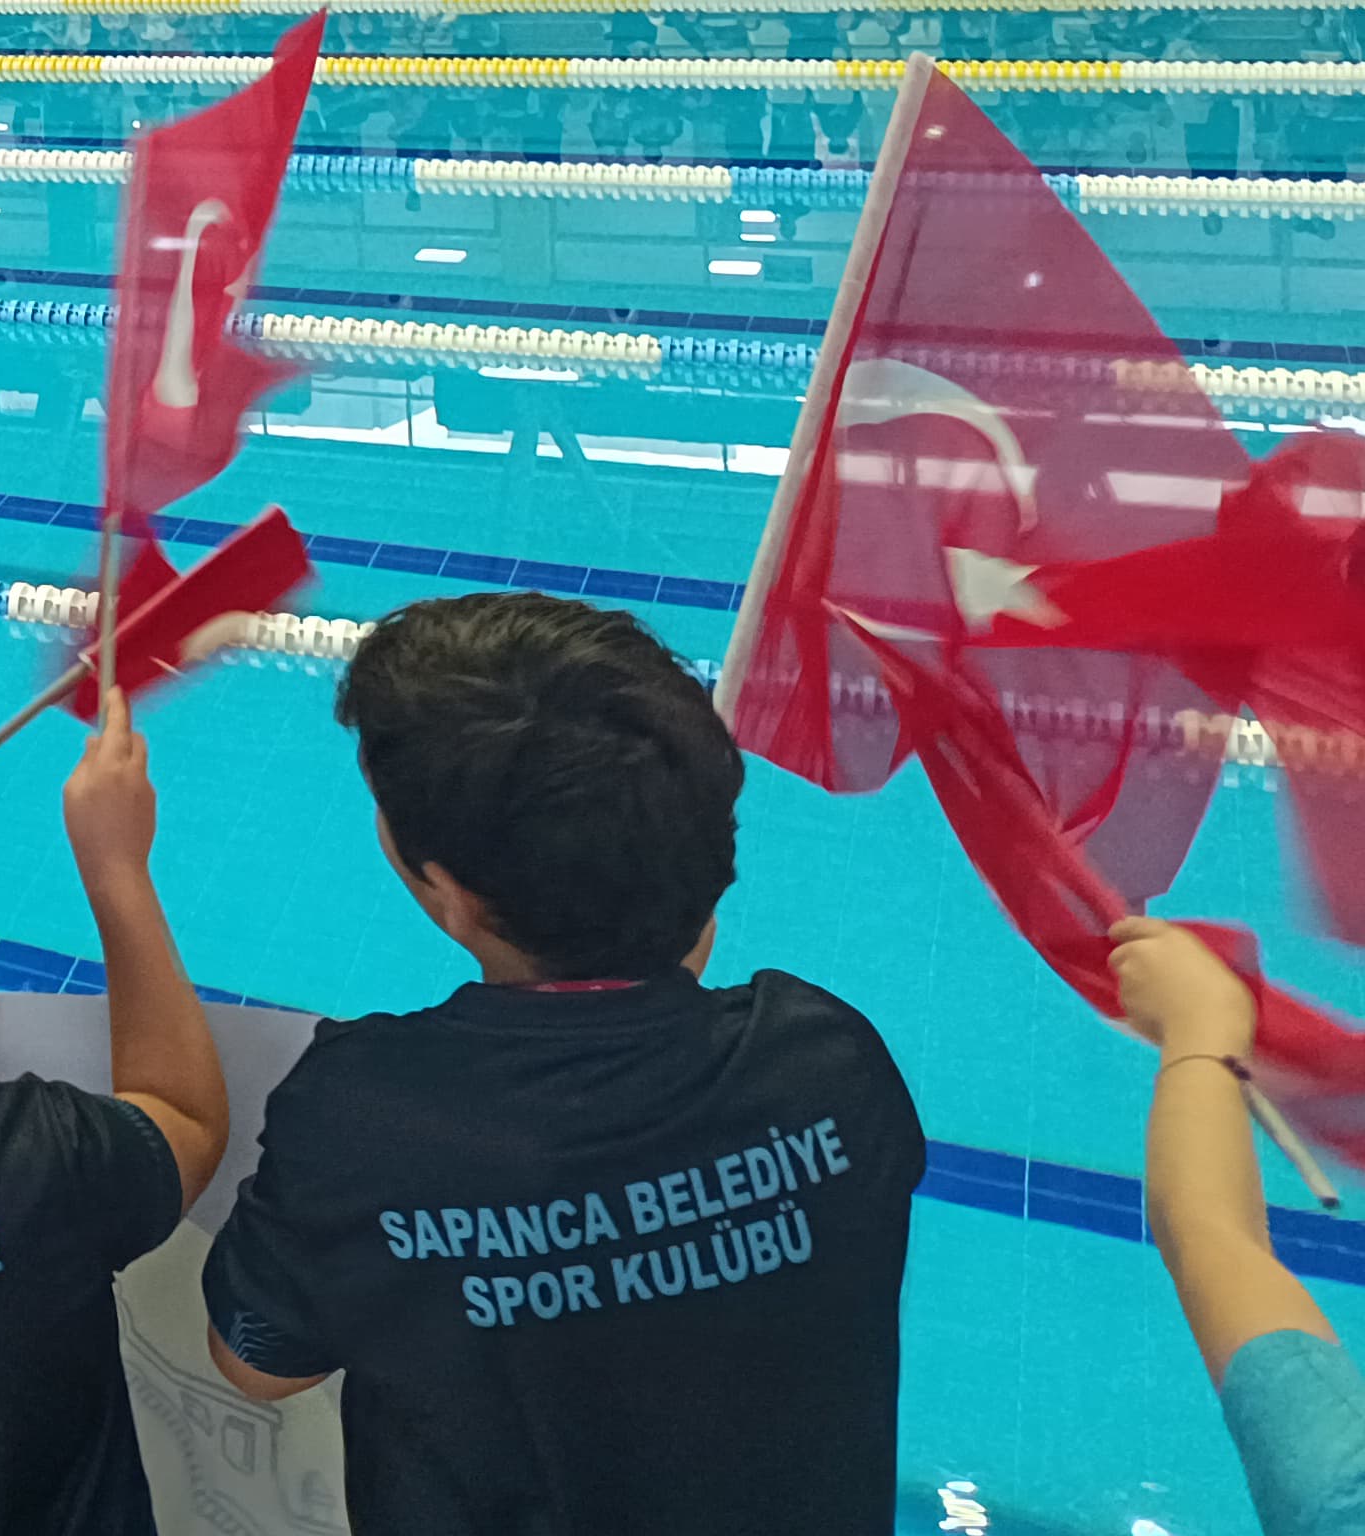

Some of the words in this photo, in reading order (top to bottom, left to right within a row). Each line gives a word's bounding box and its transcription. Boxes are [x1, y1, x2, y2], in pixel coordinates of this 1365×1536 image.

[379, 1192, 620, 1260] SAPANCA
[624, 1117, 852, 1235] BELEDİYE
[462, 1265, 602, 1328] SPOR
[610, 1199, 813, 1304] KULÜBÜ
